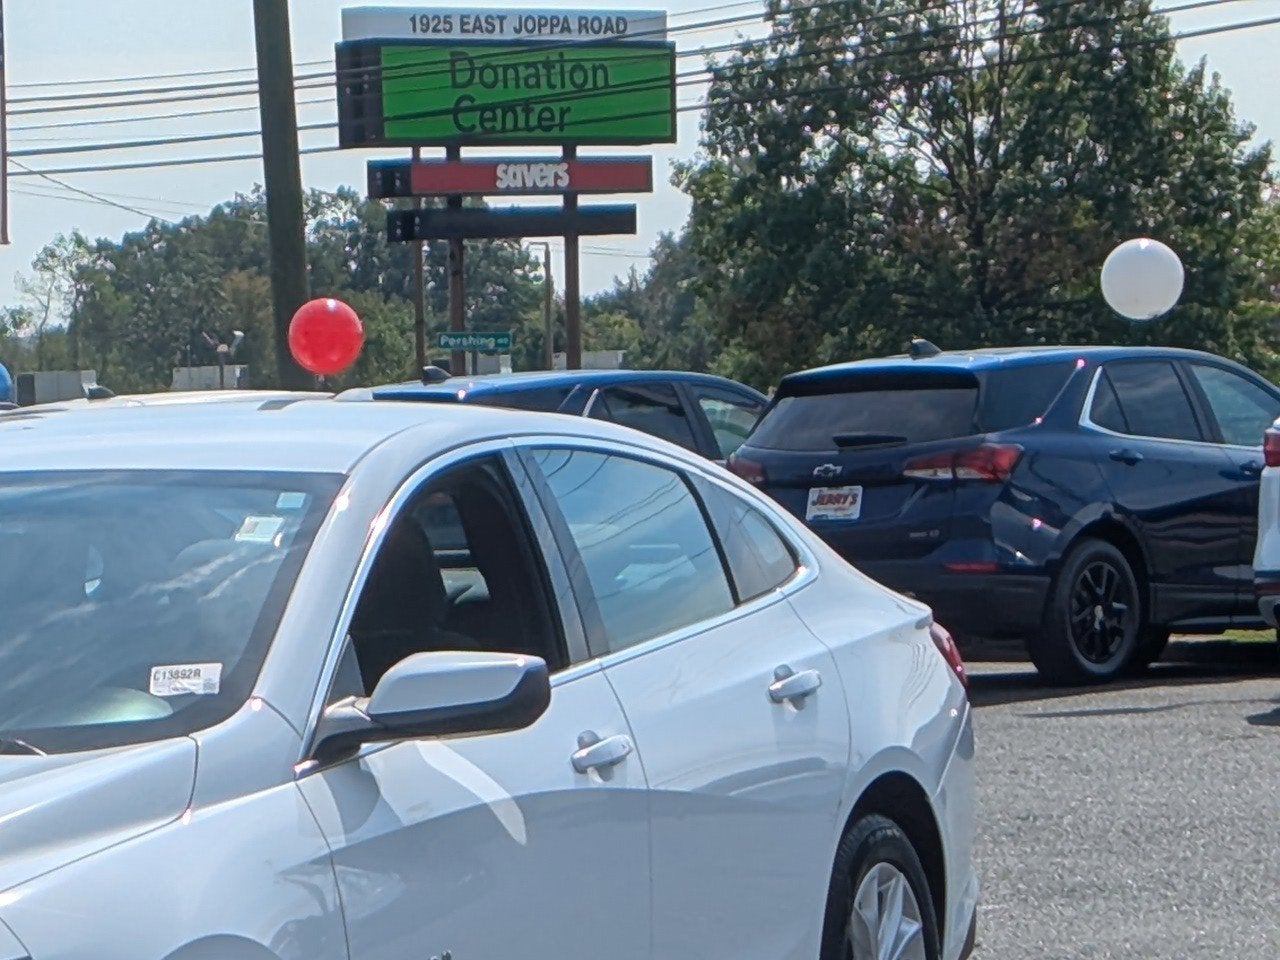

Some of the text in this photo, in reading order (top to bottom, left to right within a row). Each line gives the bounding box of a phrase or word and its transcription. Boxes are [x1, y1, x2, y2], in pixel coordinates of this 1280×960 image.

[409, 15, 628, 34] 1925 EAST JOPPA ROAD
[450, 51, 609, 89] Donation
[452, 94, 571, 133] Center
[496, 162, 569, 188] savers
